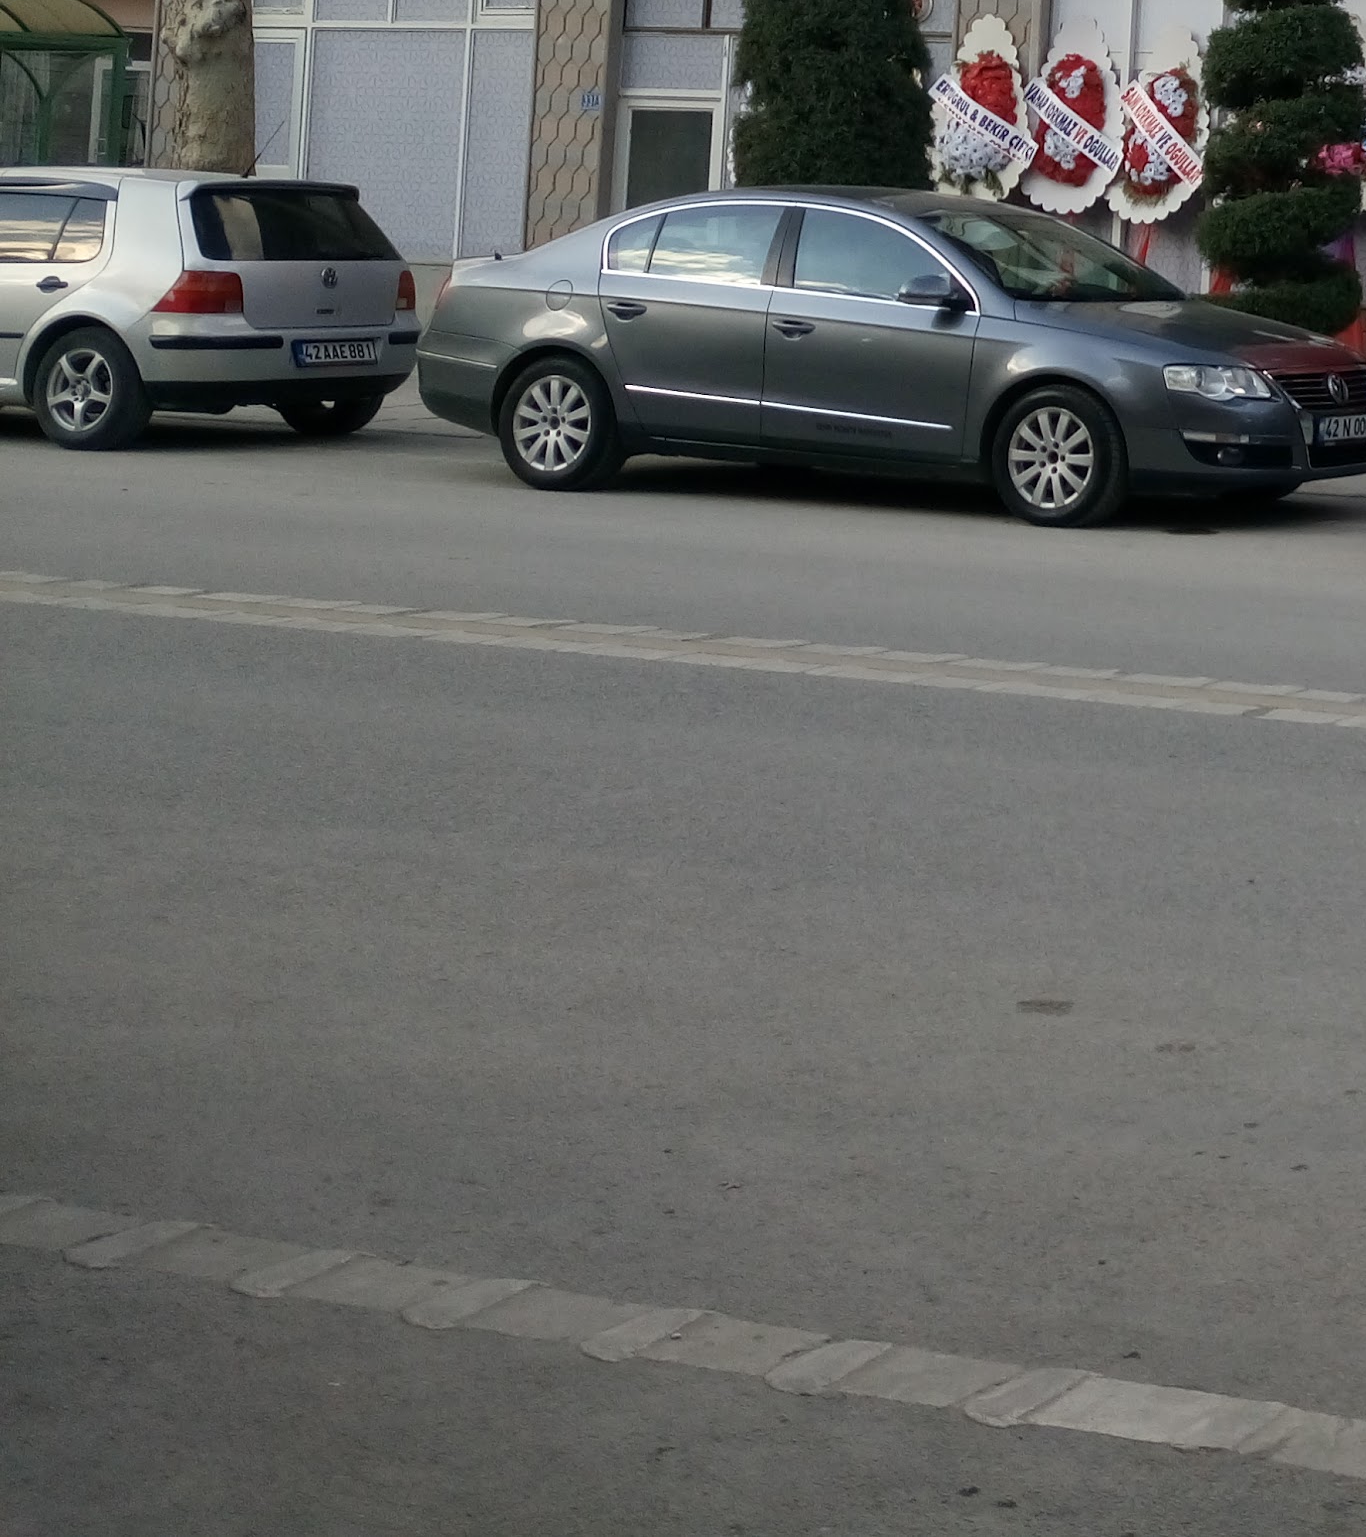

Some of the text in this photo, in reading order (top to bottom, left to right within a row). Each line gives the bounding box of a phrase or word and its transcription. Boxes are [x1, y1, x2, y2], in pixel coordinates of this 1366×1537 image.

[1072, 125, 1088, 145] VE
[1155, 130, 1173, 150] VE
[1325, 417, 1340, 439] 42
[1342, 418, 1352, 437] N
